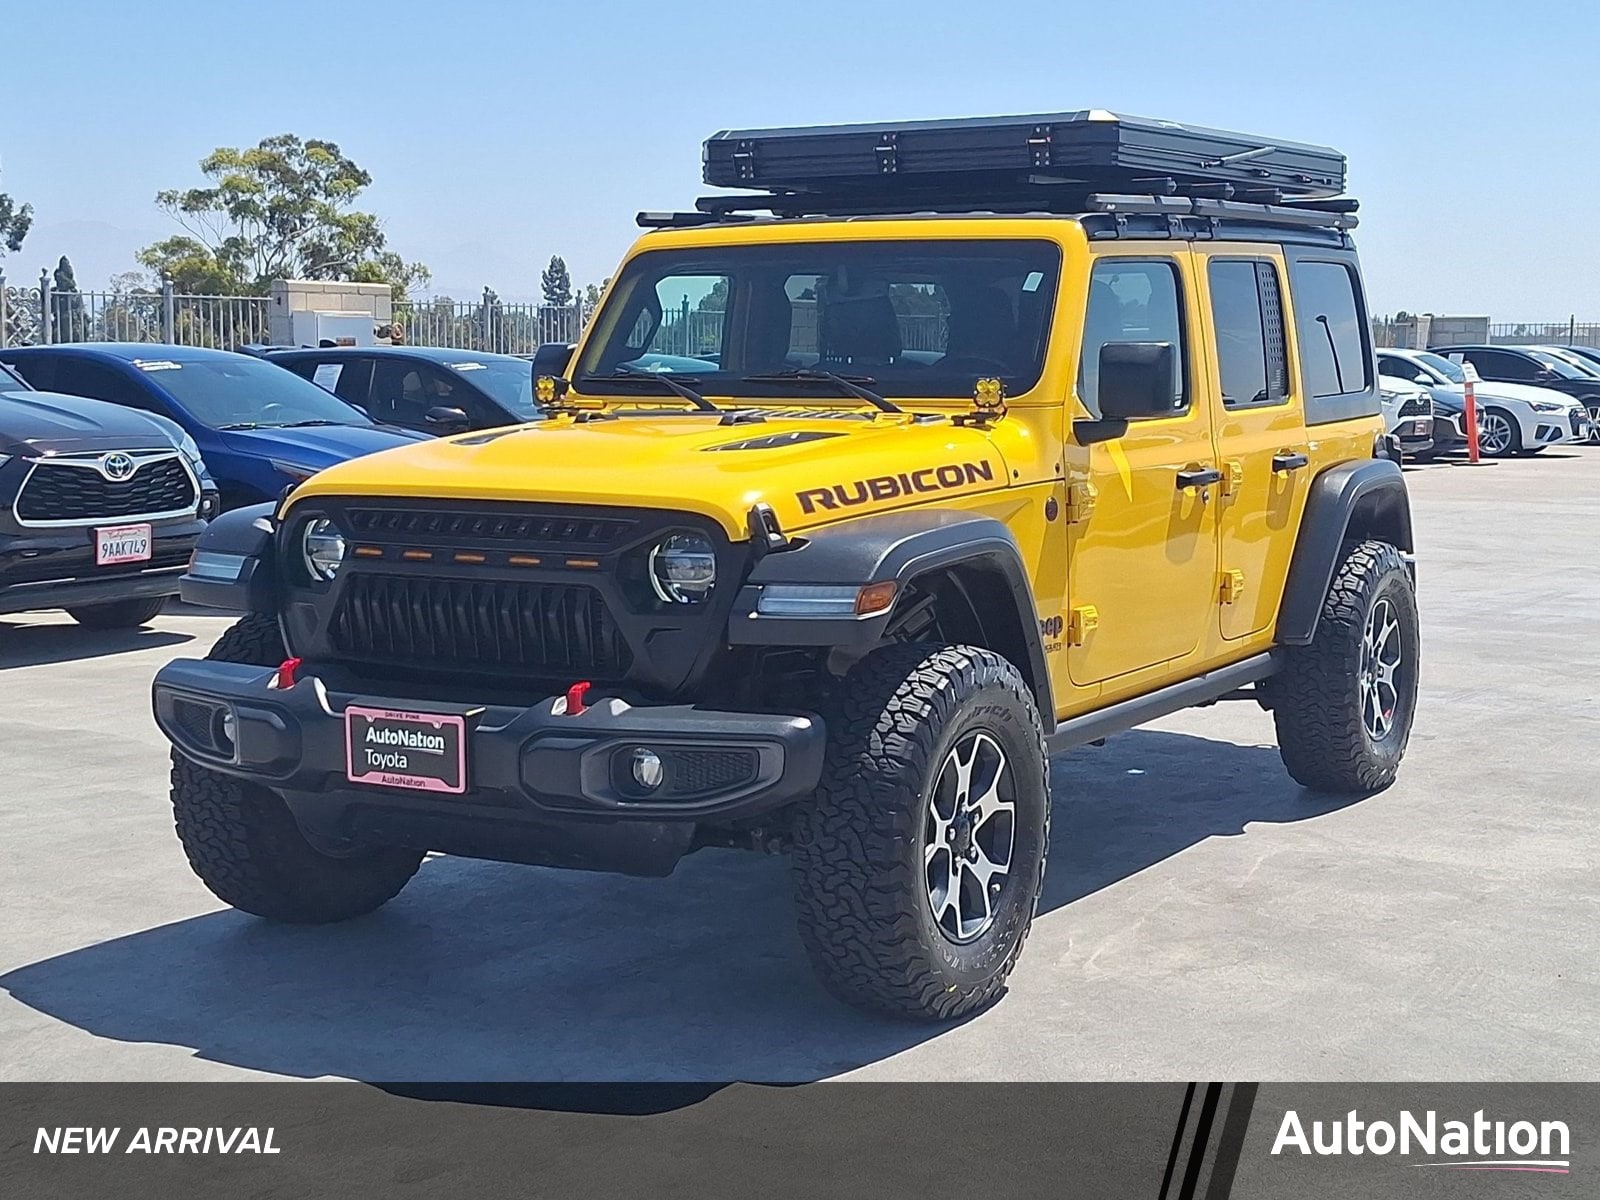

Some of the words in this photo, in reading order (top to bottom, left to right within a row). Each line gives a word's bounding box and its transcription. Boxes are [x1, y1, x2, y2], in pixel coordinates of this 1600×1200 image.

[796, 460, 993, 514] RUBICON
[102, 539, 147, 558] 9AAK749
[366, 726, 445, 749] AutoNation
[365, 748, 407, 769] Toyota
[381, 775, 426, 788] AutoNation
